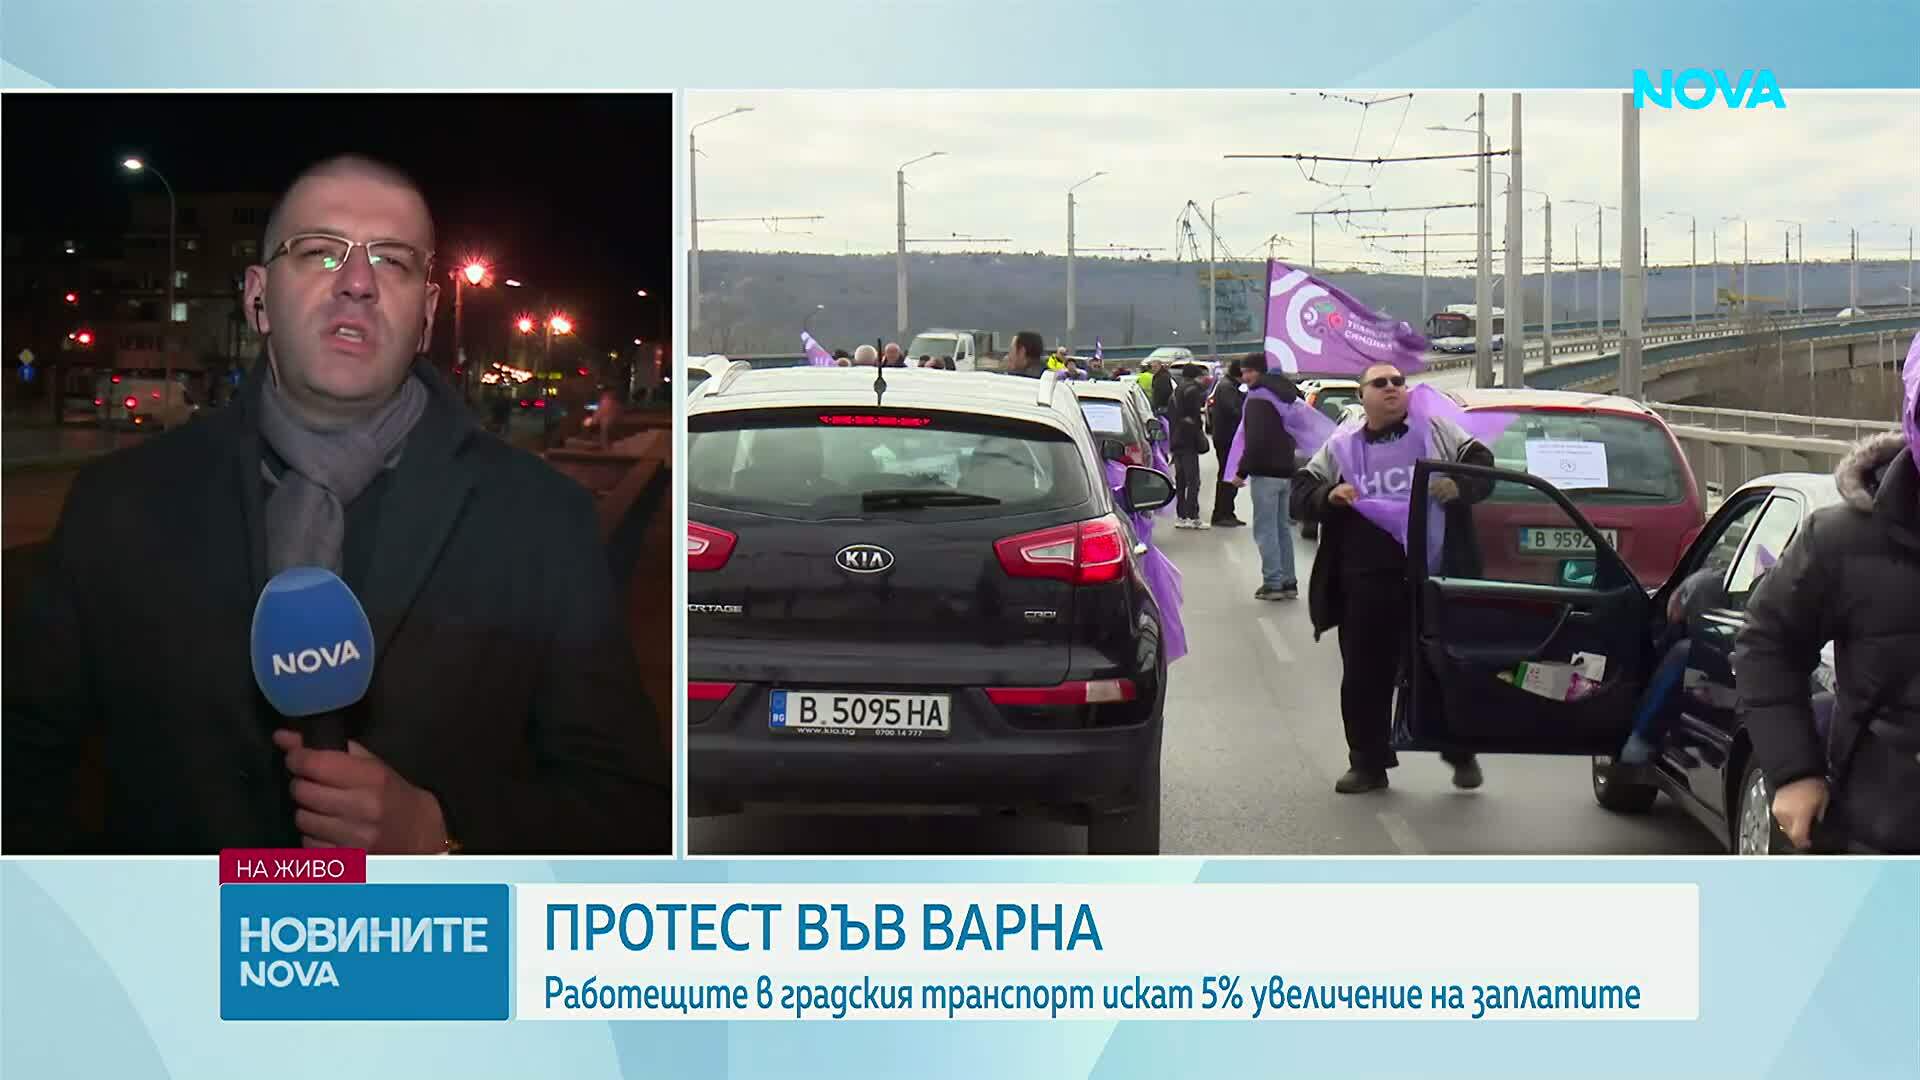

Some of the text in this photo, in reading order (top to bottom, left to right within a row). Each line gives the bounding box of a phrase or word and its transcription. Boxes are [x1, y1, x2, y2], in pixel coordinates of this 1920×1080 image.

[1535, 531, 1545, 547] B
[845, 551, 884, 567] KIA
[272, 639, 361, 676] NOVA
[832, 697, 901, 725] 5095
[906, 699, 943, 727] HA
[797, 727, 856, 736] www.kia.bg
[874, 729, 895, 737] 0700
